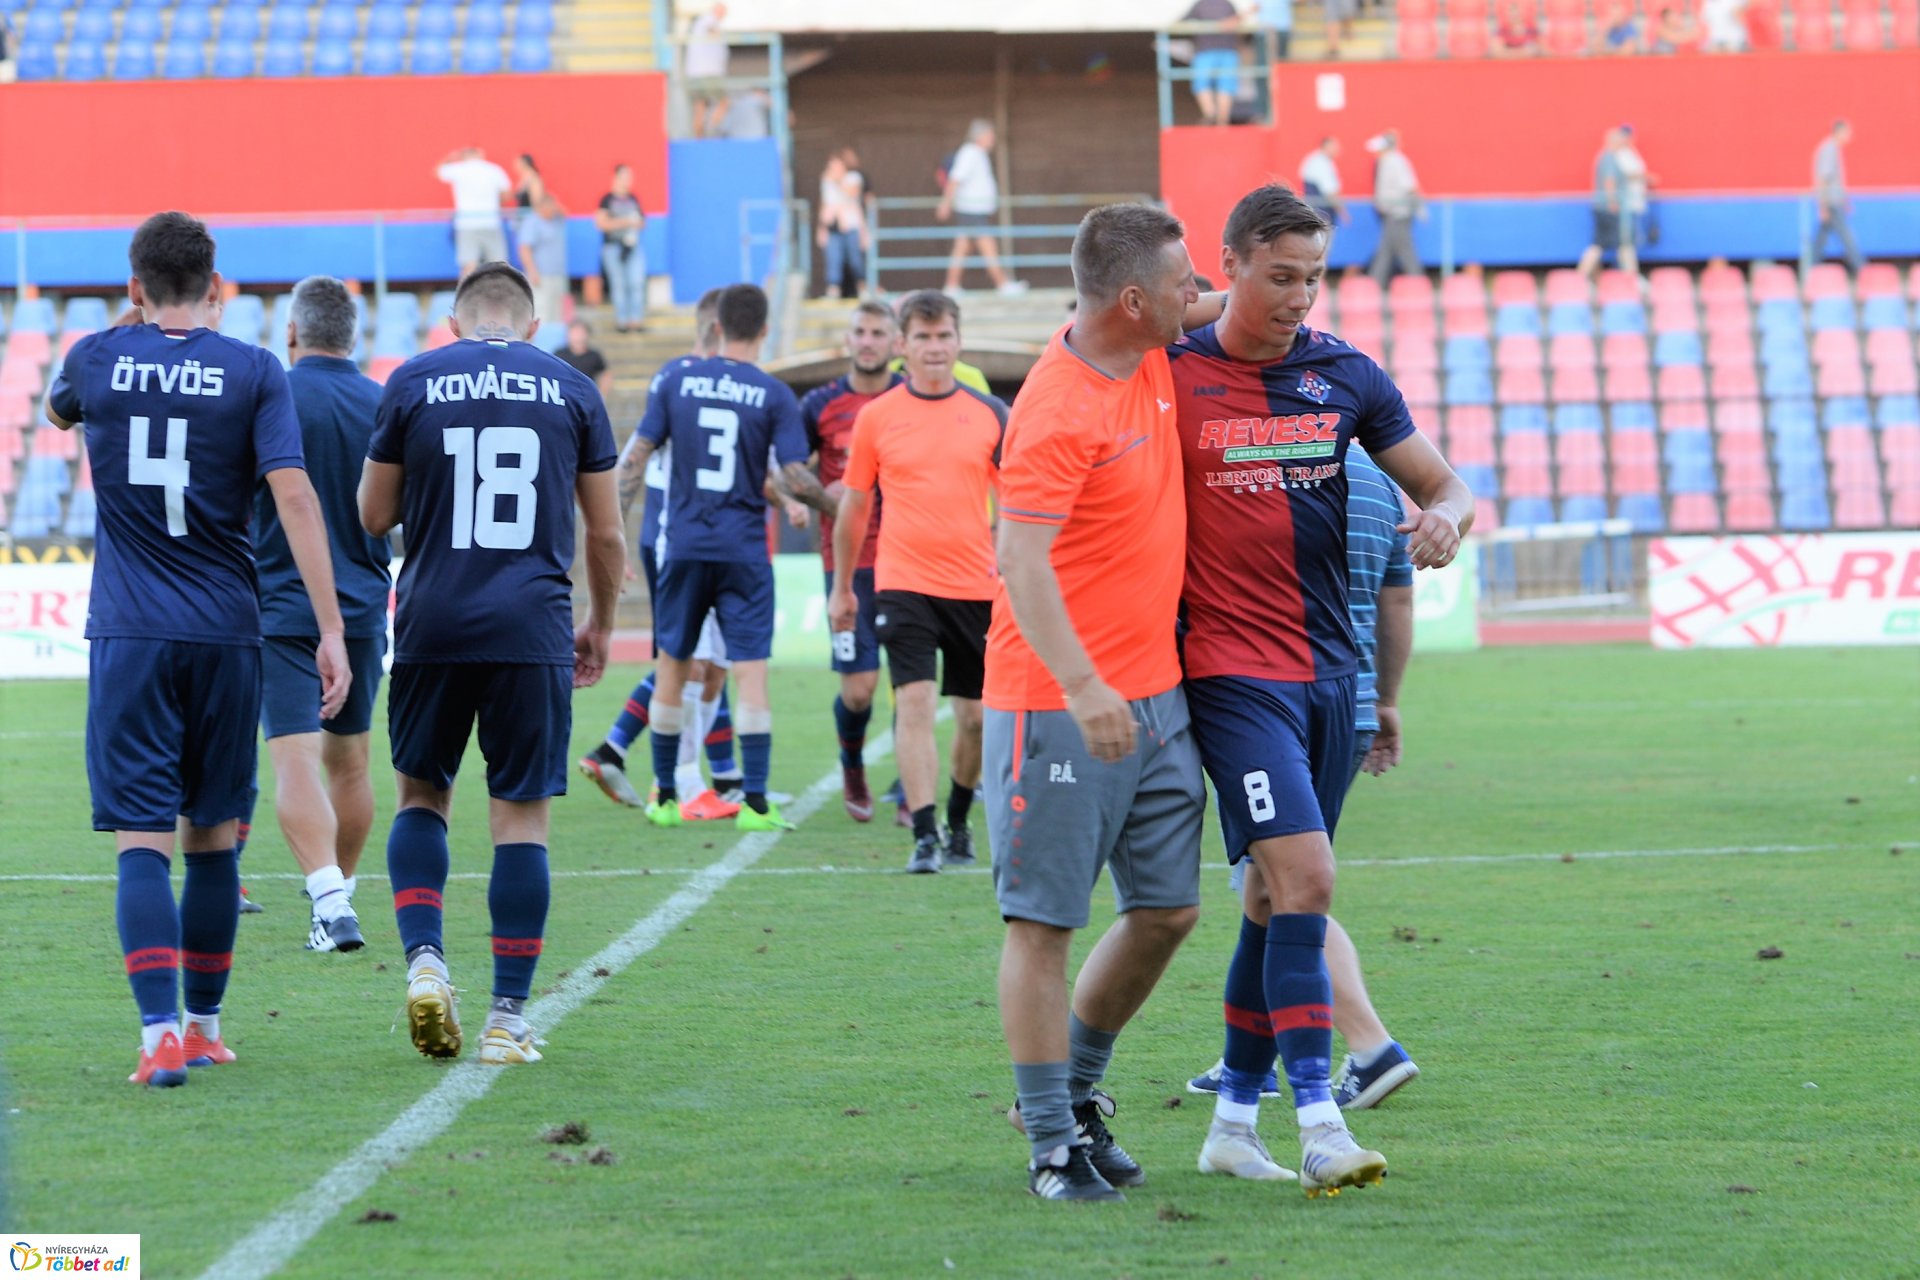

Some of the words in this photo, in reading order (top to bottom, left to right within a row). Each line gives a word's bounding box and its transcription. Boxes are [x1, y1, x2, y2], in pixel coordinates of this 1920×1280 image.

[111, 355, 225, 397] ÖTVÖS
[426, 363, 537, 405] KOVÁCS
[540, 376, 566, 406] N.
[680, 373, 767, 409] POLÉNYI
[696, 406, 739, 493] 3
[1198, 413, 1341, 449] REVESZ
[1227, 449, 1260, 459] ALWAYS
[1261, 448, 1274, 457] ON
[1275, 447, 1291, 456] THE
[1292, 446, 1316, 455] RIGHT
[1317, 445, 1331, 453] WAY
[128, 415, 191, 537] 4
[443, 426, 541, 550] 18
[1205, 467, 1284, 487] LERTON
[1243, 770, 1276, 823] 8
